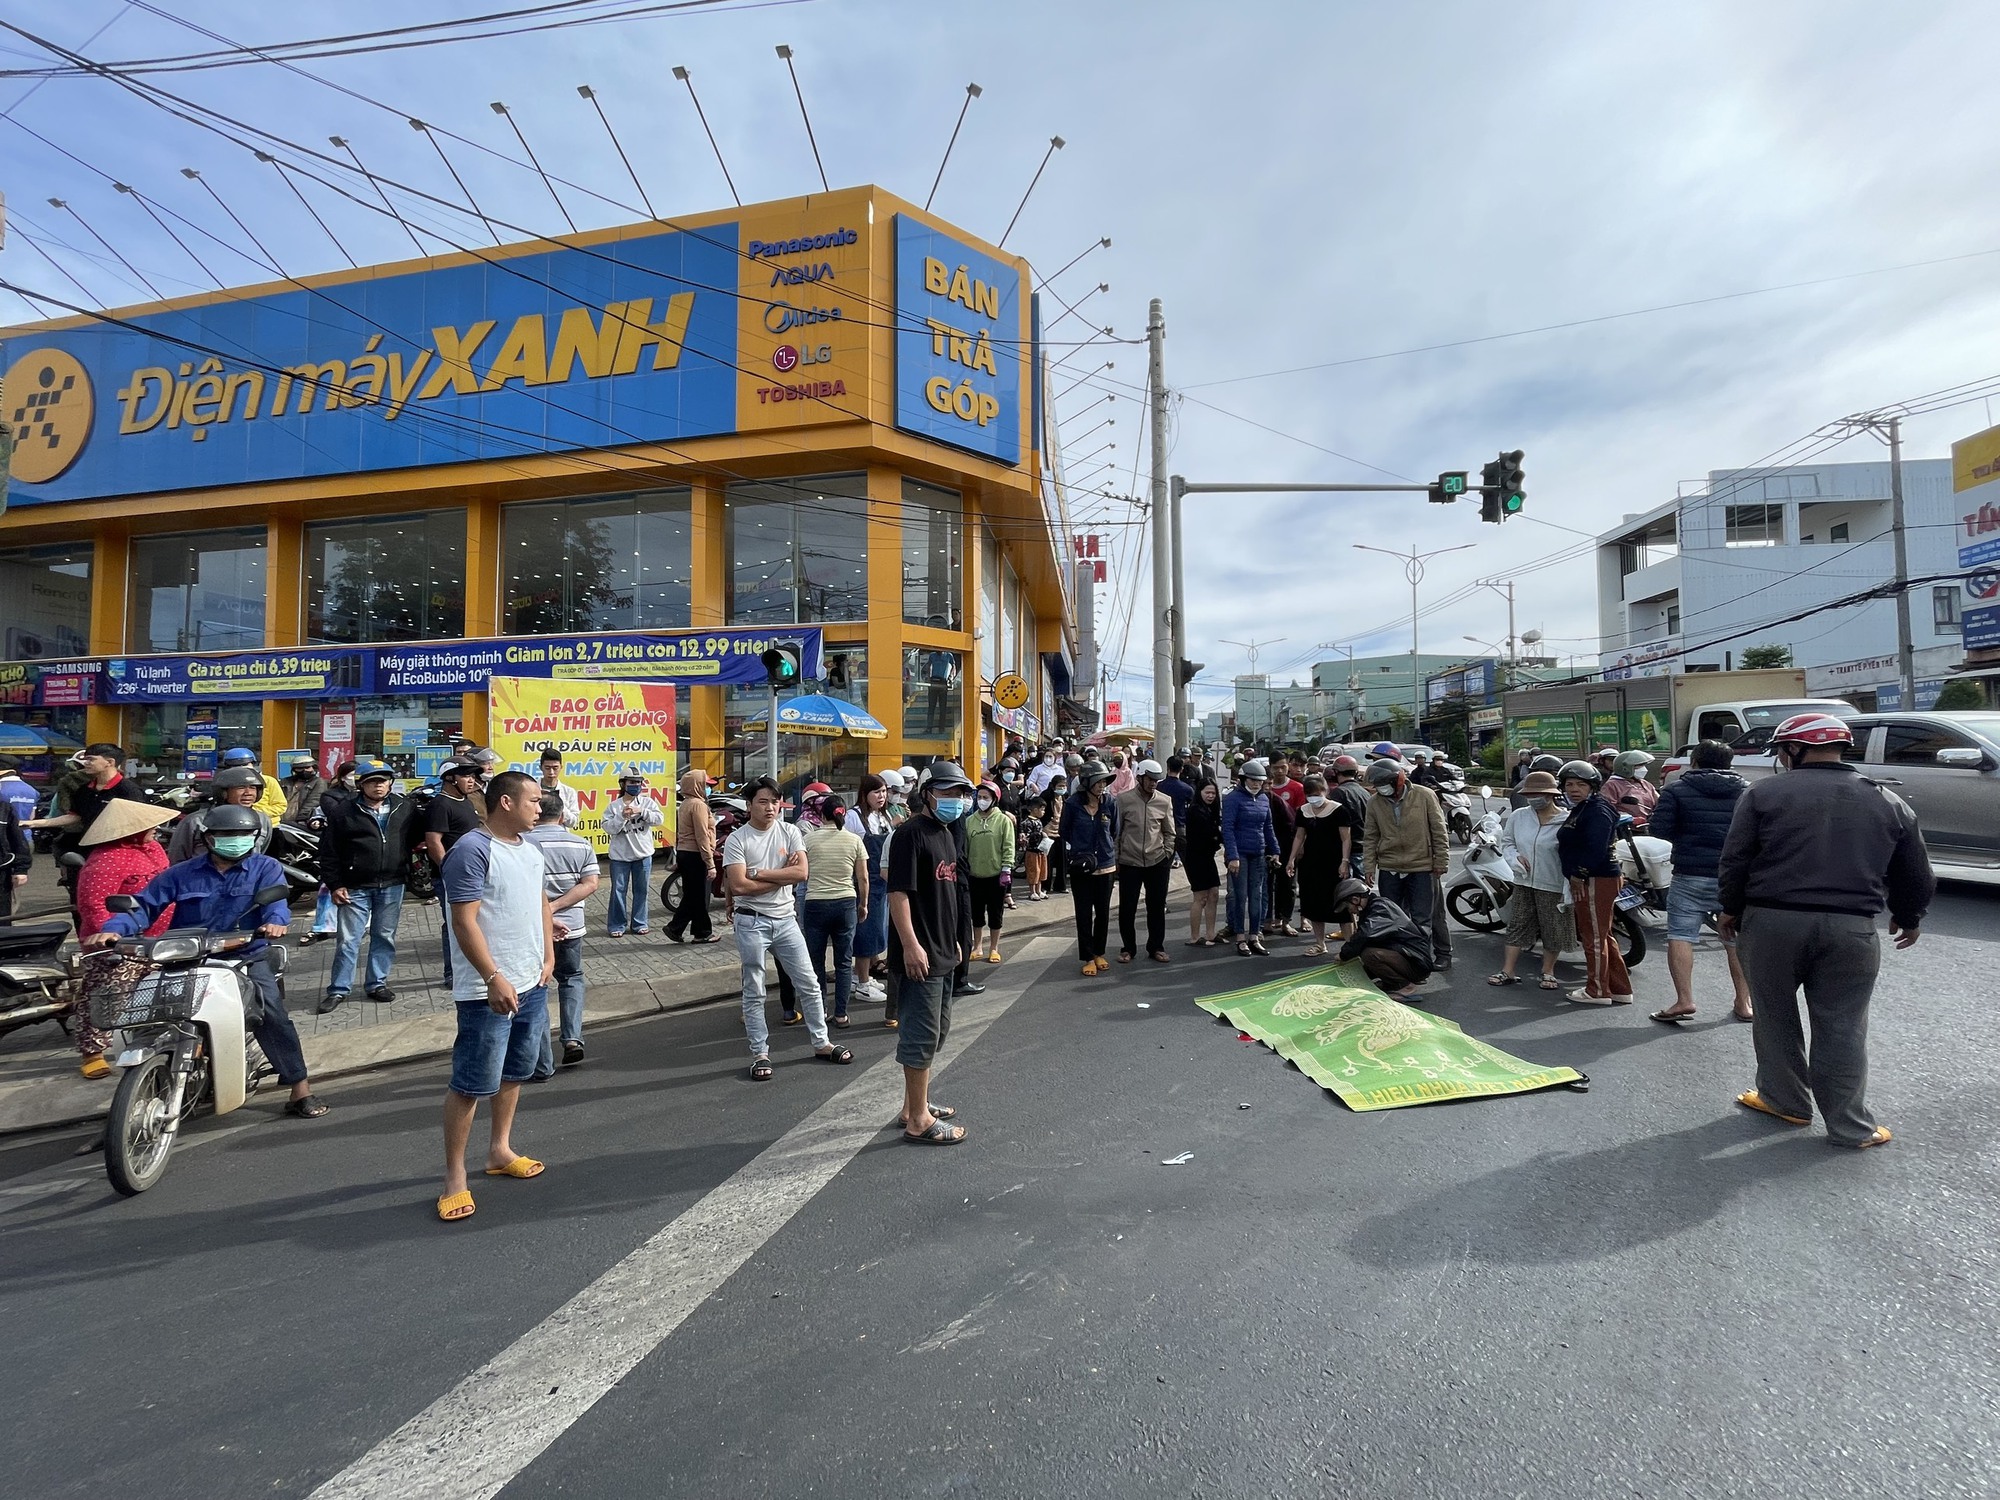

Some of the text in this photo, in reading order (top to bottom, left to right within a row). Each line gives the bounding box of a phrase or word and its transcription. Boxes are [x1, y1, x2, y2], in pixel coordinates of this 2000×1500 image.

[749, 227, 857, 259] Panasonic
[770, 262, 834, 287] AQUA
[925, 256, 999, 320] BÁN
[764, 290, 841, 333] Midea
[802, 344, 832, 365] LG
[927, 317, 997, 376] TRẢ
[117, 291, 695, 441] Điện máy XANH
[757, 379, 846, 404] TOSHIBA
[926, 376, 1000, 427] GÓP
[1445, 477, 1462, 492] 20
[380, 651, 502, 672] Máy giặt thông minh
[506, 645, 545, 664] Giảm
[549, 644, 573, 661] lớn
[576, 642, 603, 662] 2,7
[606, 643, 643, 661] triệu
[646, 642, 676, 658] còn
[679, 638, 730, 659] 12,99
[56, 662, 102, 675] SAMSUNG
[150, 666, 171, 681] lạnh
[269, 657, 299, 676] 6,39
[403, 669, 467, 686] EcoBubble
[550, 694, 625, 714] BAO GIÁ
[504, 710, 668, 733] TOÀN THỊ TRƯỜNG
[524, 738, 652, 752] NƠI ĐÂU RẺ HƠN
[566, 758, 608, 775] MÁY
